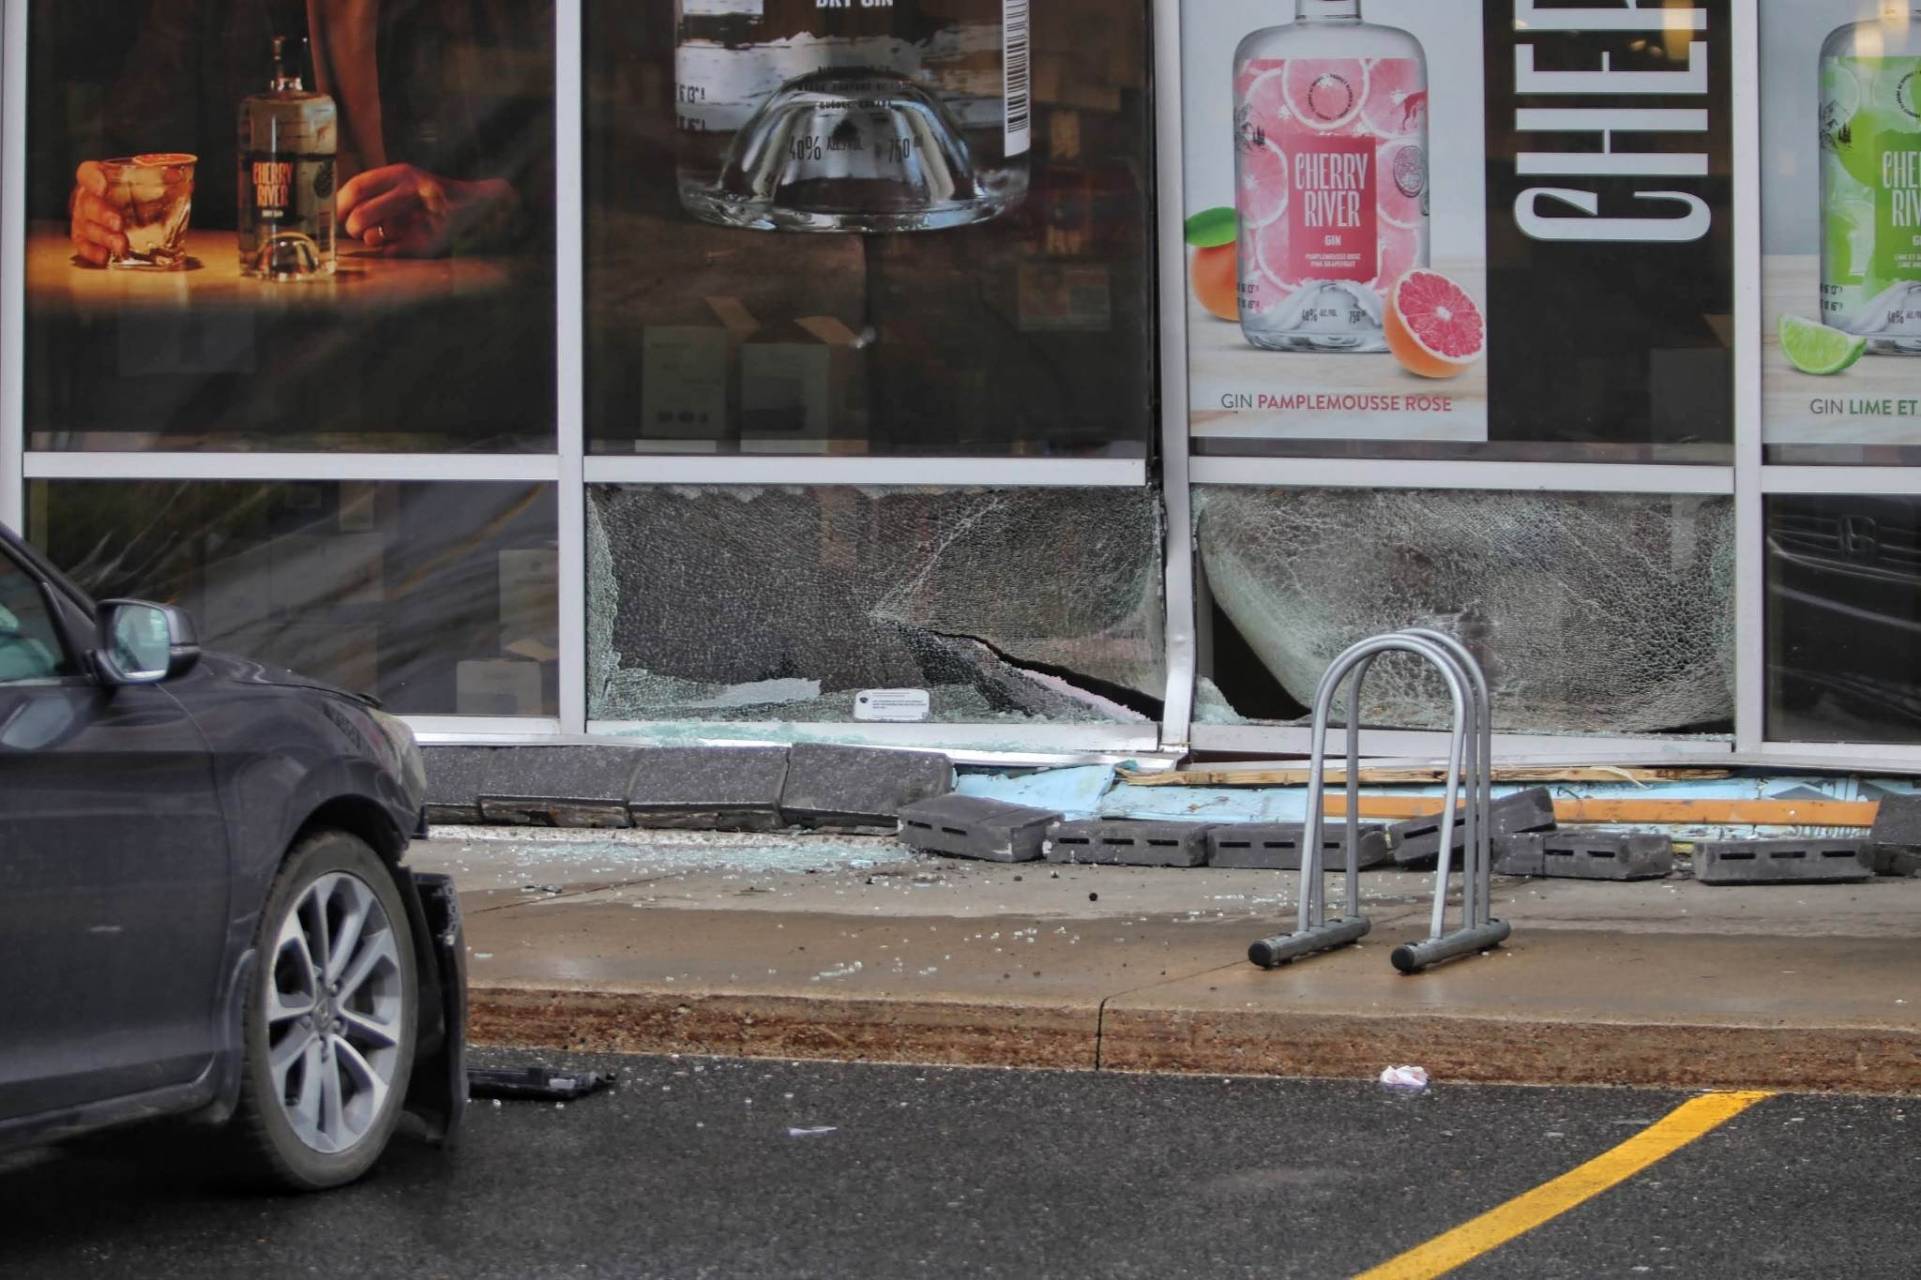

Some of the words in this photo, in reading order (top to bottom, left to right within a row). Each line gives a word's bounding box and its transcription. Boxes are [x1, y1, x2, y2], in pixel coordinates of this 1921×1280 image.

[789, 135, 822, 160] 40%
[252, 162, 293, 184] CHERRY
[1294, 152, 1369, 190] CHERRY
[1882, 151, 1921, 189] CHE
[257, 184, 289, 207] RIVER
[1304, 190, 1362, 227] RIVER
[1324, 234, 1342, 246] GIN
[1220, 393, 1252, 409] GIN
[1257, 394, 1401, 411] PAMPLEMOUSSE
[1404, 396, 1453, 412] ROSE
[1809, 398, 1844, 415] GIN
[1849, 399, 1893, 415] LIME
[1897, 399, 1919, 416] ET
